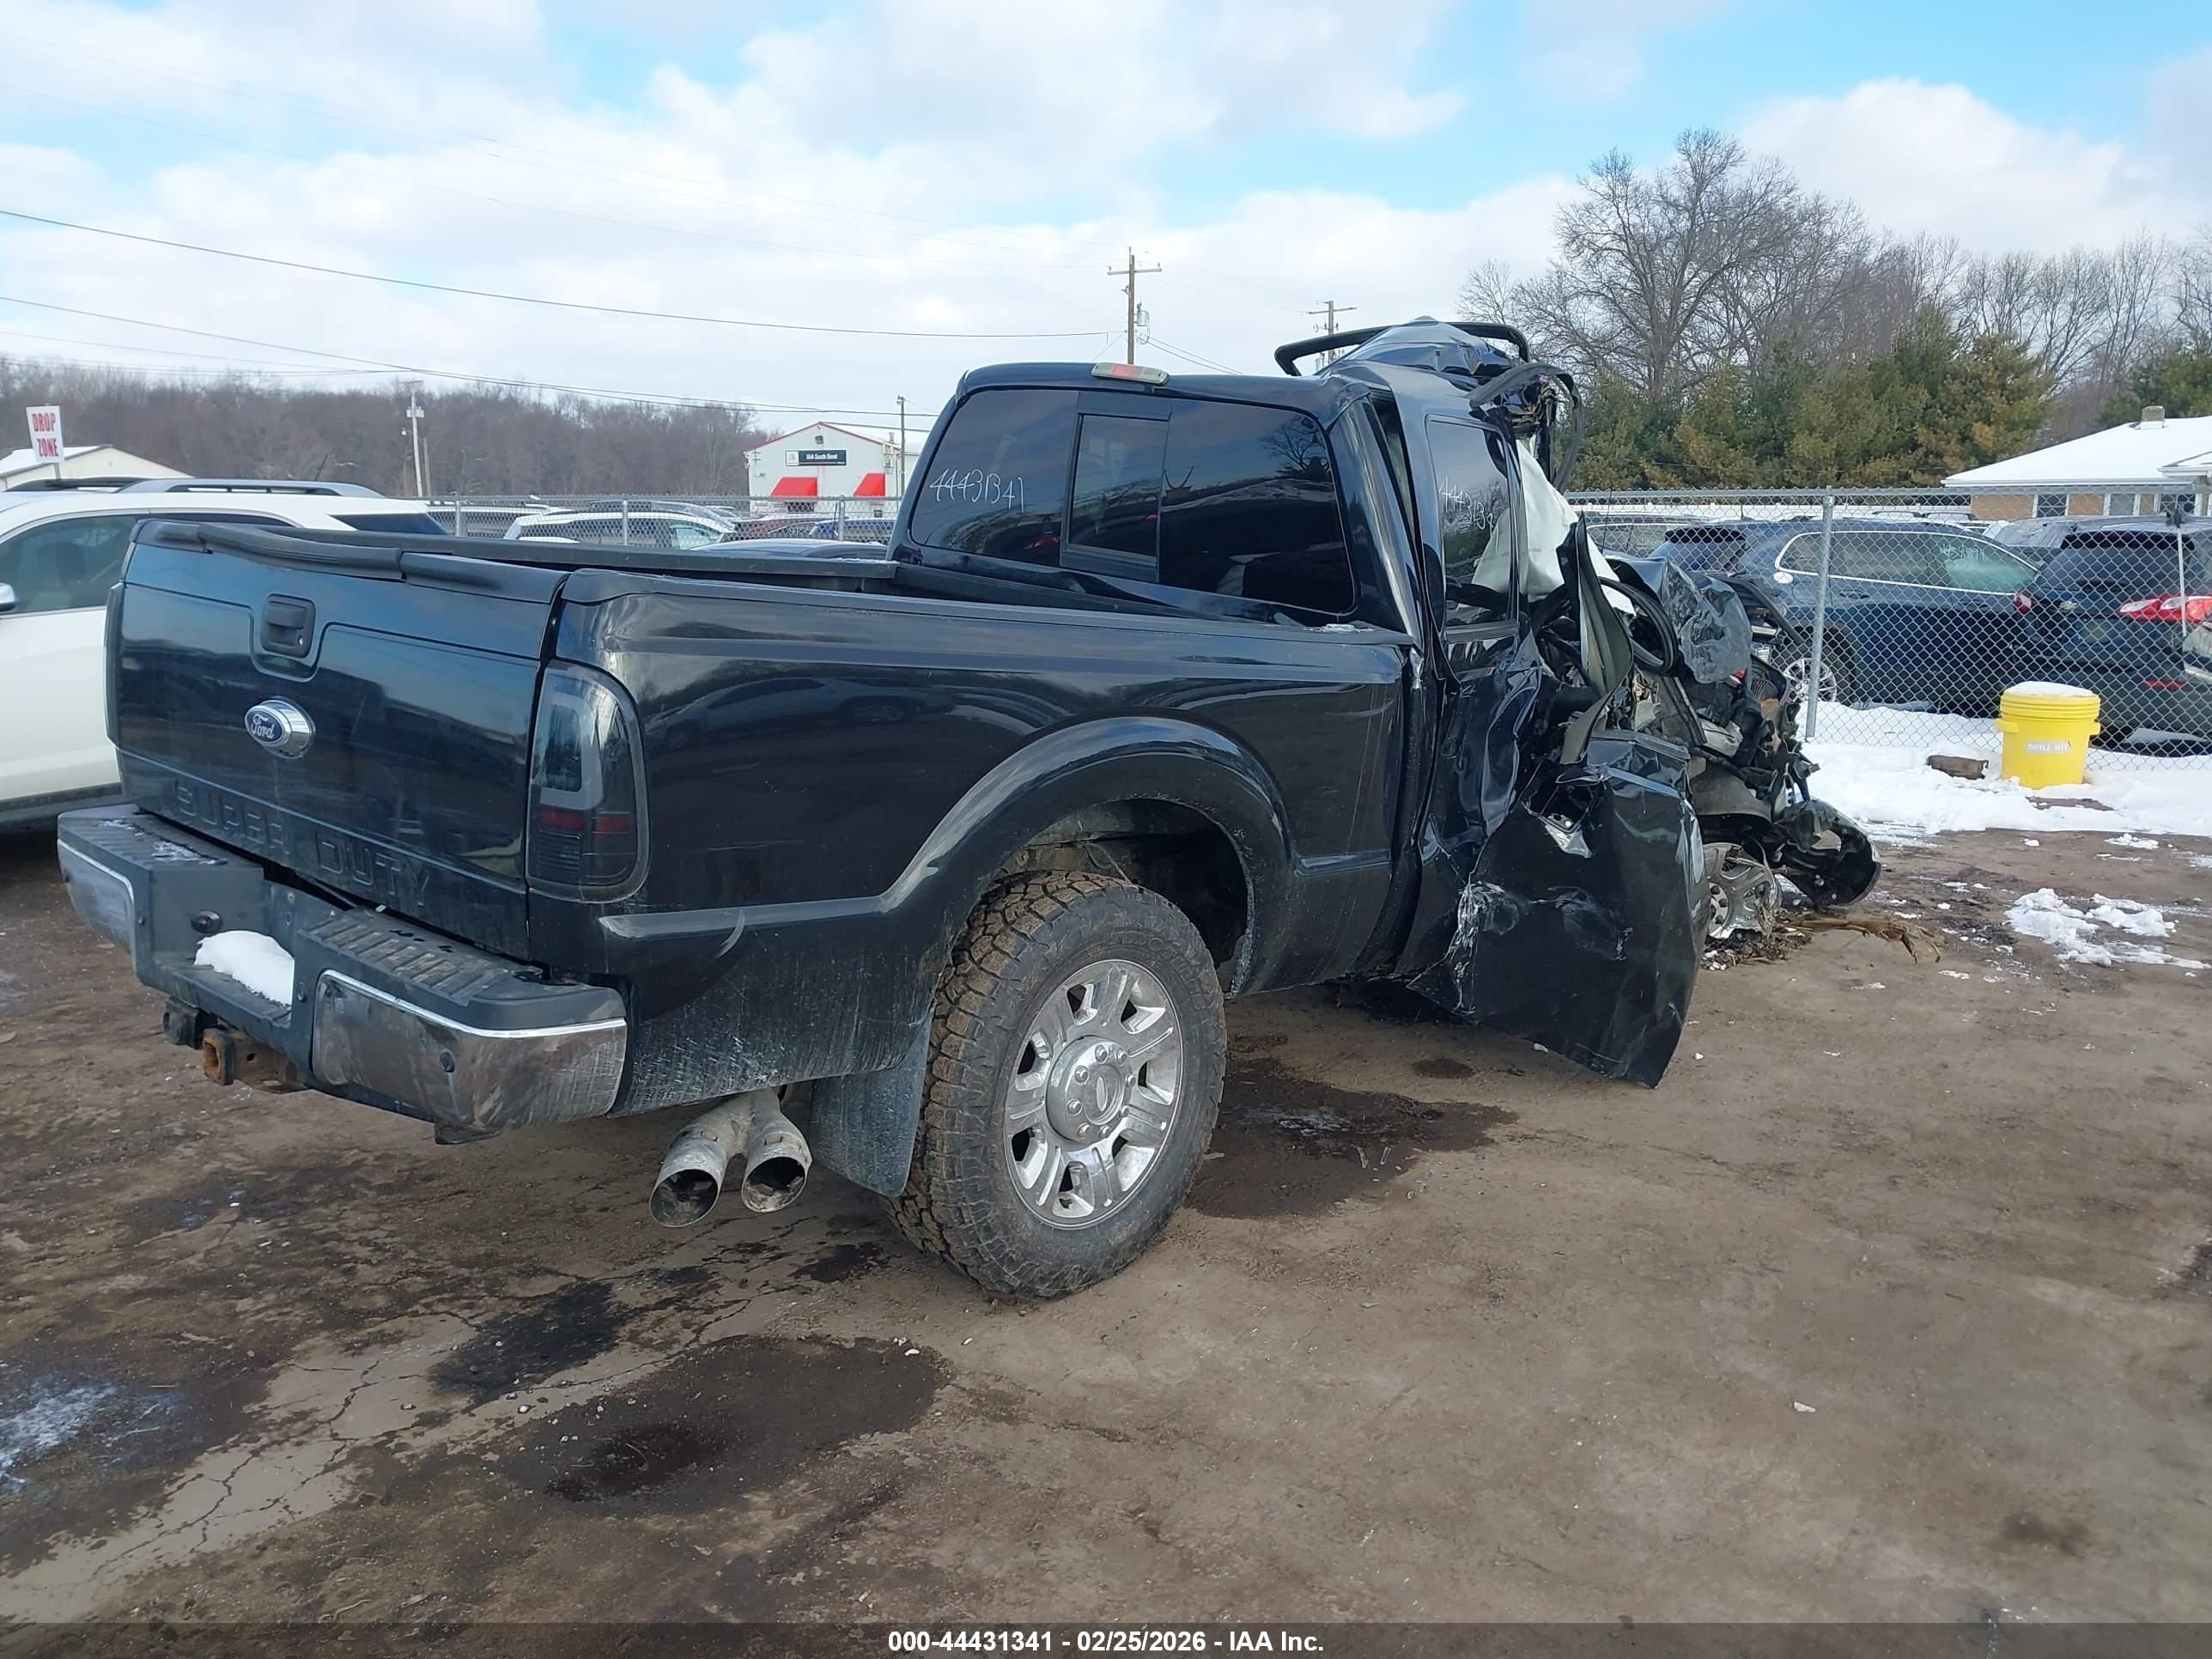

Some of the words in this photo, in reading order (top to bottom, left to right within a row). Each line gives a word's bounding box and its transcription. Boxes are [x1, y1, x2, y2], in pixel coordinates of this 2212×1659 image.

[32, 412, 56, 432] DROP
[36, 438, 58, 457] ZONE
[929, 469, 1024, 514] 44431341
[252, 714, 275, 739] Ford
[174, 780, 290, 855] SUPER
[315, 830, 430, 906] DUTY
